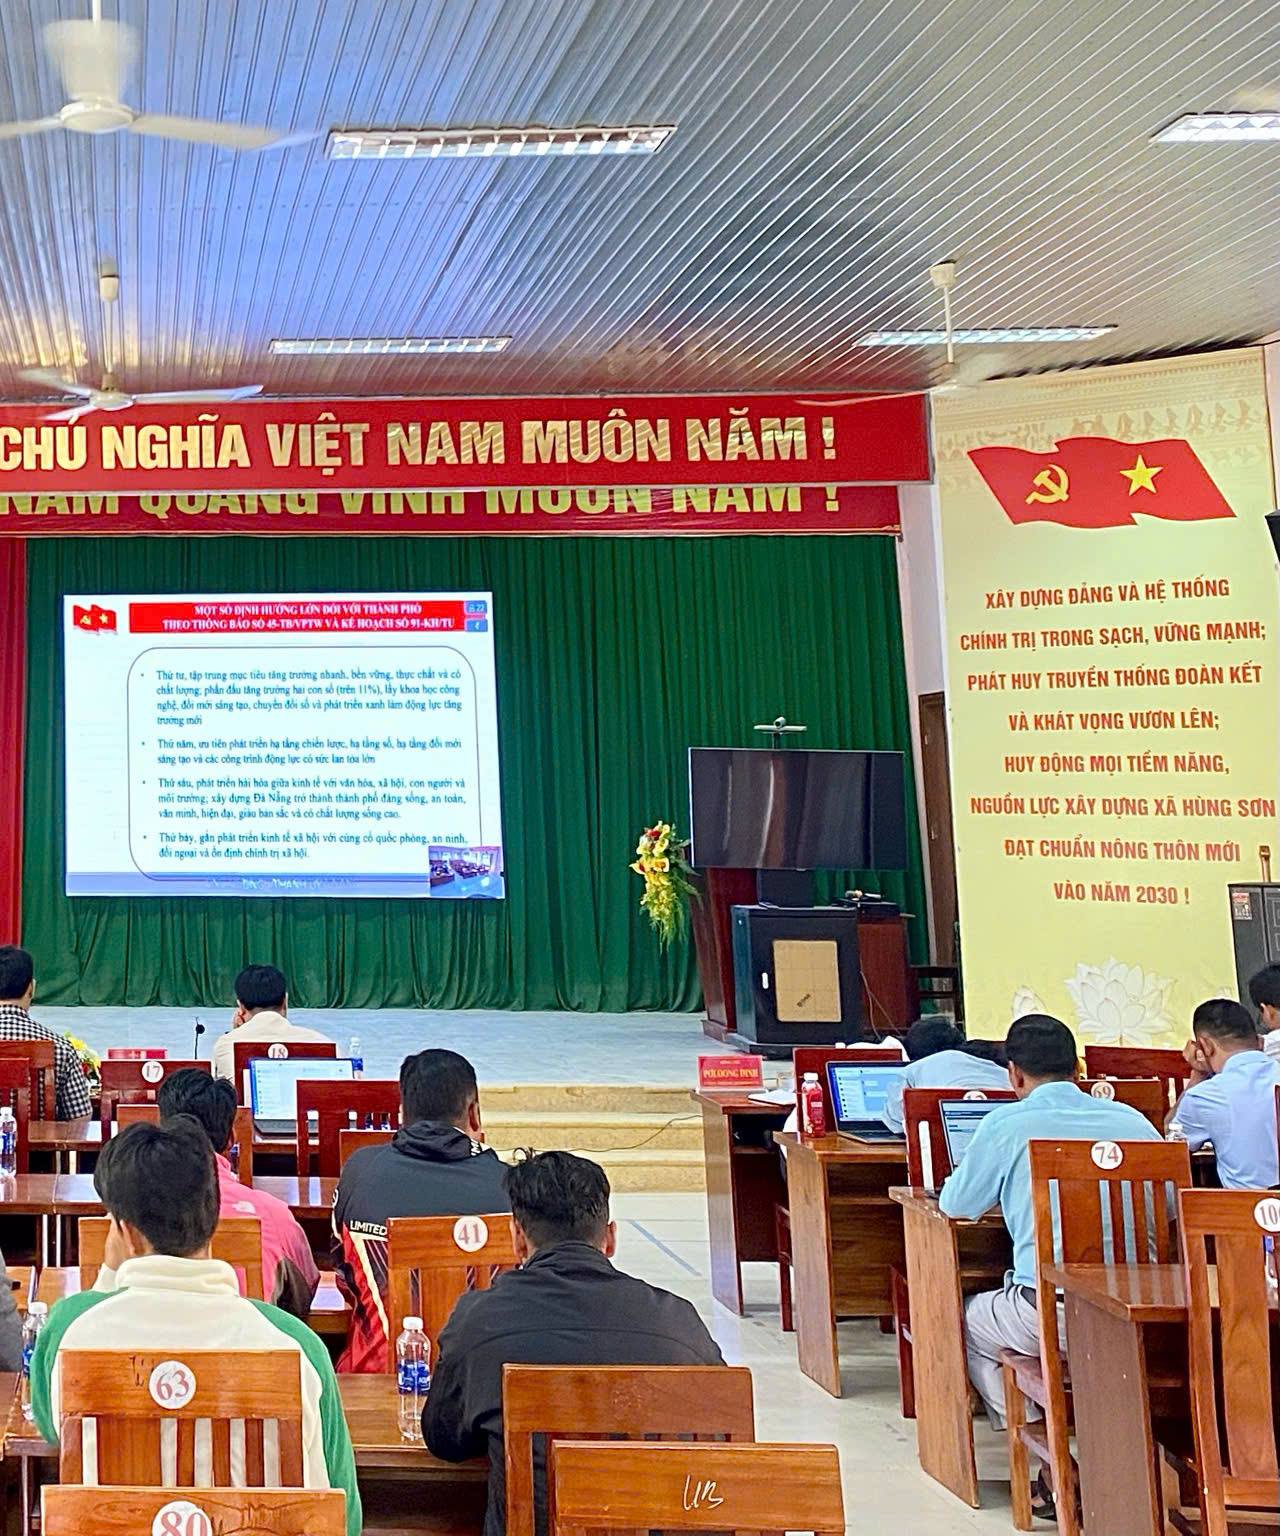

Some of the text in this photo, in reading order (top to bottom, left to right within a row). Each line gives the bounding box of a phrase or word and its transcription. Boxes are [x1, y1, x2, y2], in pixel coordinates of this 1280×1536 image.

[101, 413, 251, 471] NGHĨA
[264, 412, 370, 476] VIỆT
[387, 420, 505, 466] NAM
[521, 408, 671, 465] MUÔN
[686, 407, 807, 462] NĂM
[985, 574, 1230, 610] XÂY DỰNG ĐẢNG VÀ HỆ THỐNG
[960, 621, 1266, 652] CHÍNH TRỊ TRONG SẠCH, VỮNG MẠNH;
[968, 660, 1262, 691] PHÁT HUY TRUYỀN THỐNG ĐOÀN KẾT
[1009, 708, 1219, 733] VÀ KHÁT VỌNG VƯƠN LÊN;
[1004, 750, 1230, 776] HUY ĐỘNG MỌI TIỀM NĂNG,
[971, 792, 1276, 819] NGUỒN LỰC XÂY DỰNG XÃ HÙNG SƠN
[1005, 833, 1241, 862] ĐẠT CHUẨN NÔNG THÔN MỚI
[1054, 880, 1086, 900] VÀO
[1091, 881, 1130, 902] NĂM
[1136, 886, 1178, 904] 2030
[146, 1065, 160, 1078] 17
[1095, 1146, 1119, 1164] 74
[350, 1220, 388, 1236] LIMITED
[1260, 1204, 1280, 1226] 10
[458, 1223, 481, 1244] 41
[156, 1369, 190, 1401] 63
